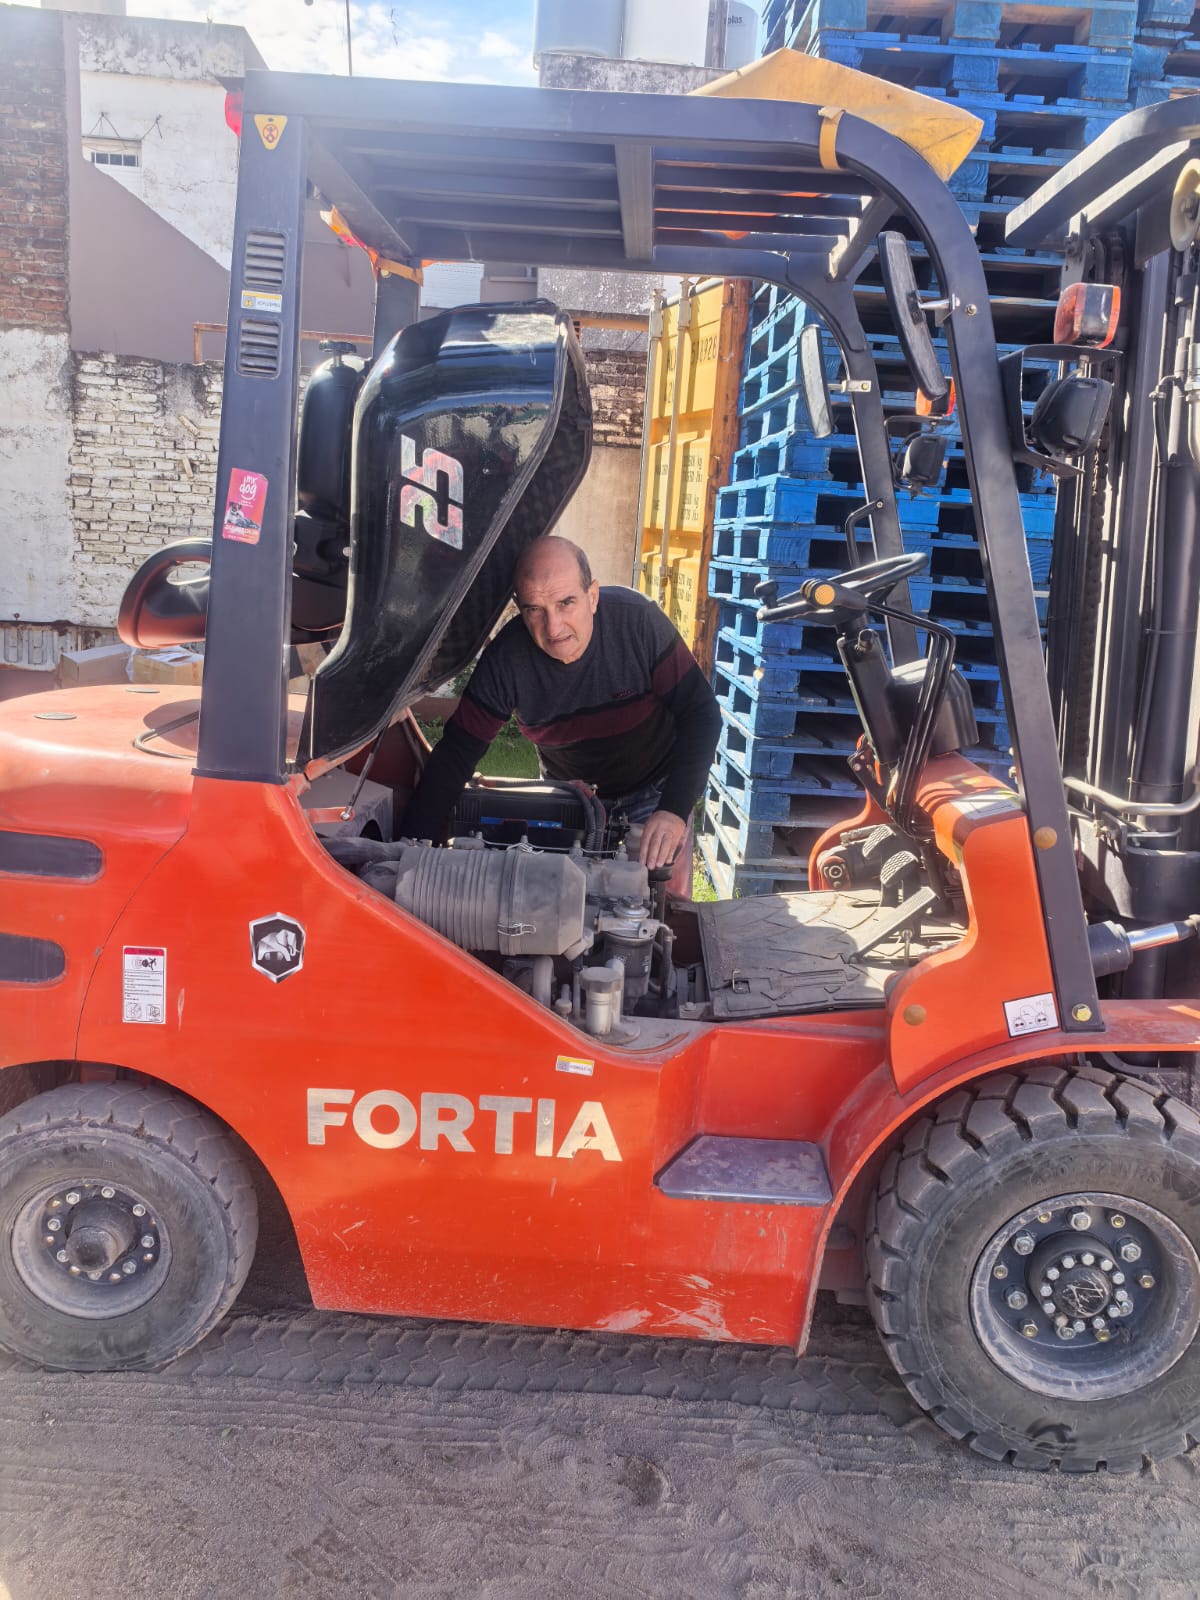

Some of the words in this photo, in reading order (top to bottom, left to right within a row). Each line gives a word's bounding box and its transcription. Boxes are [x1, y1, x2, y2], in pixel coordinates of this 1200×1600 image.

[240, 477, 257, 500] dog
[400, 434, 464, 550] 25
[307, 1088, 623, 1162] FORTIA
